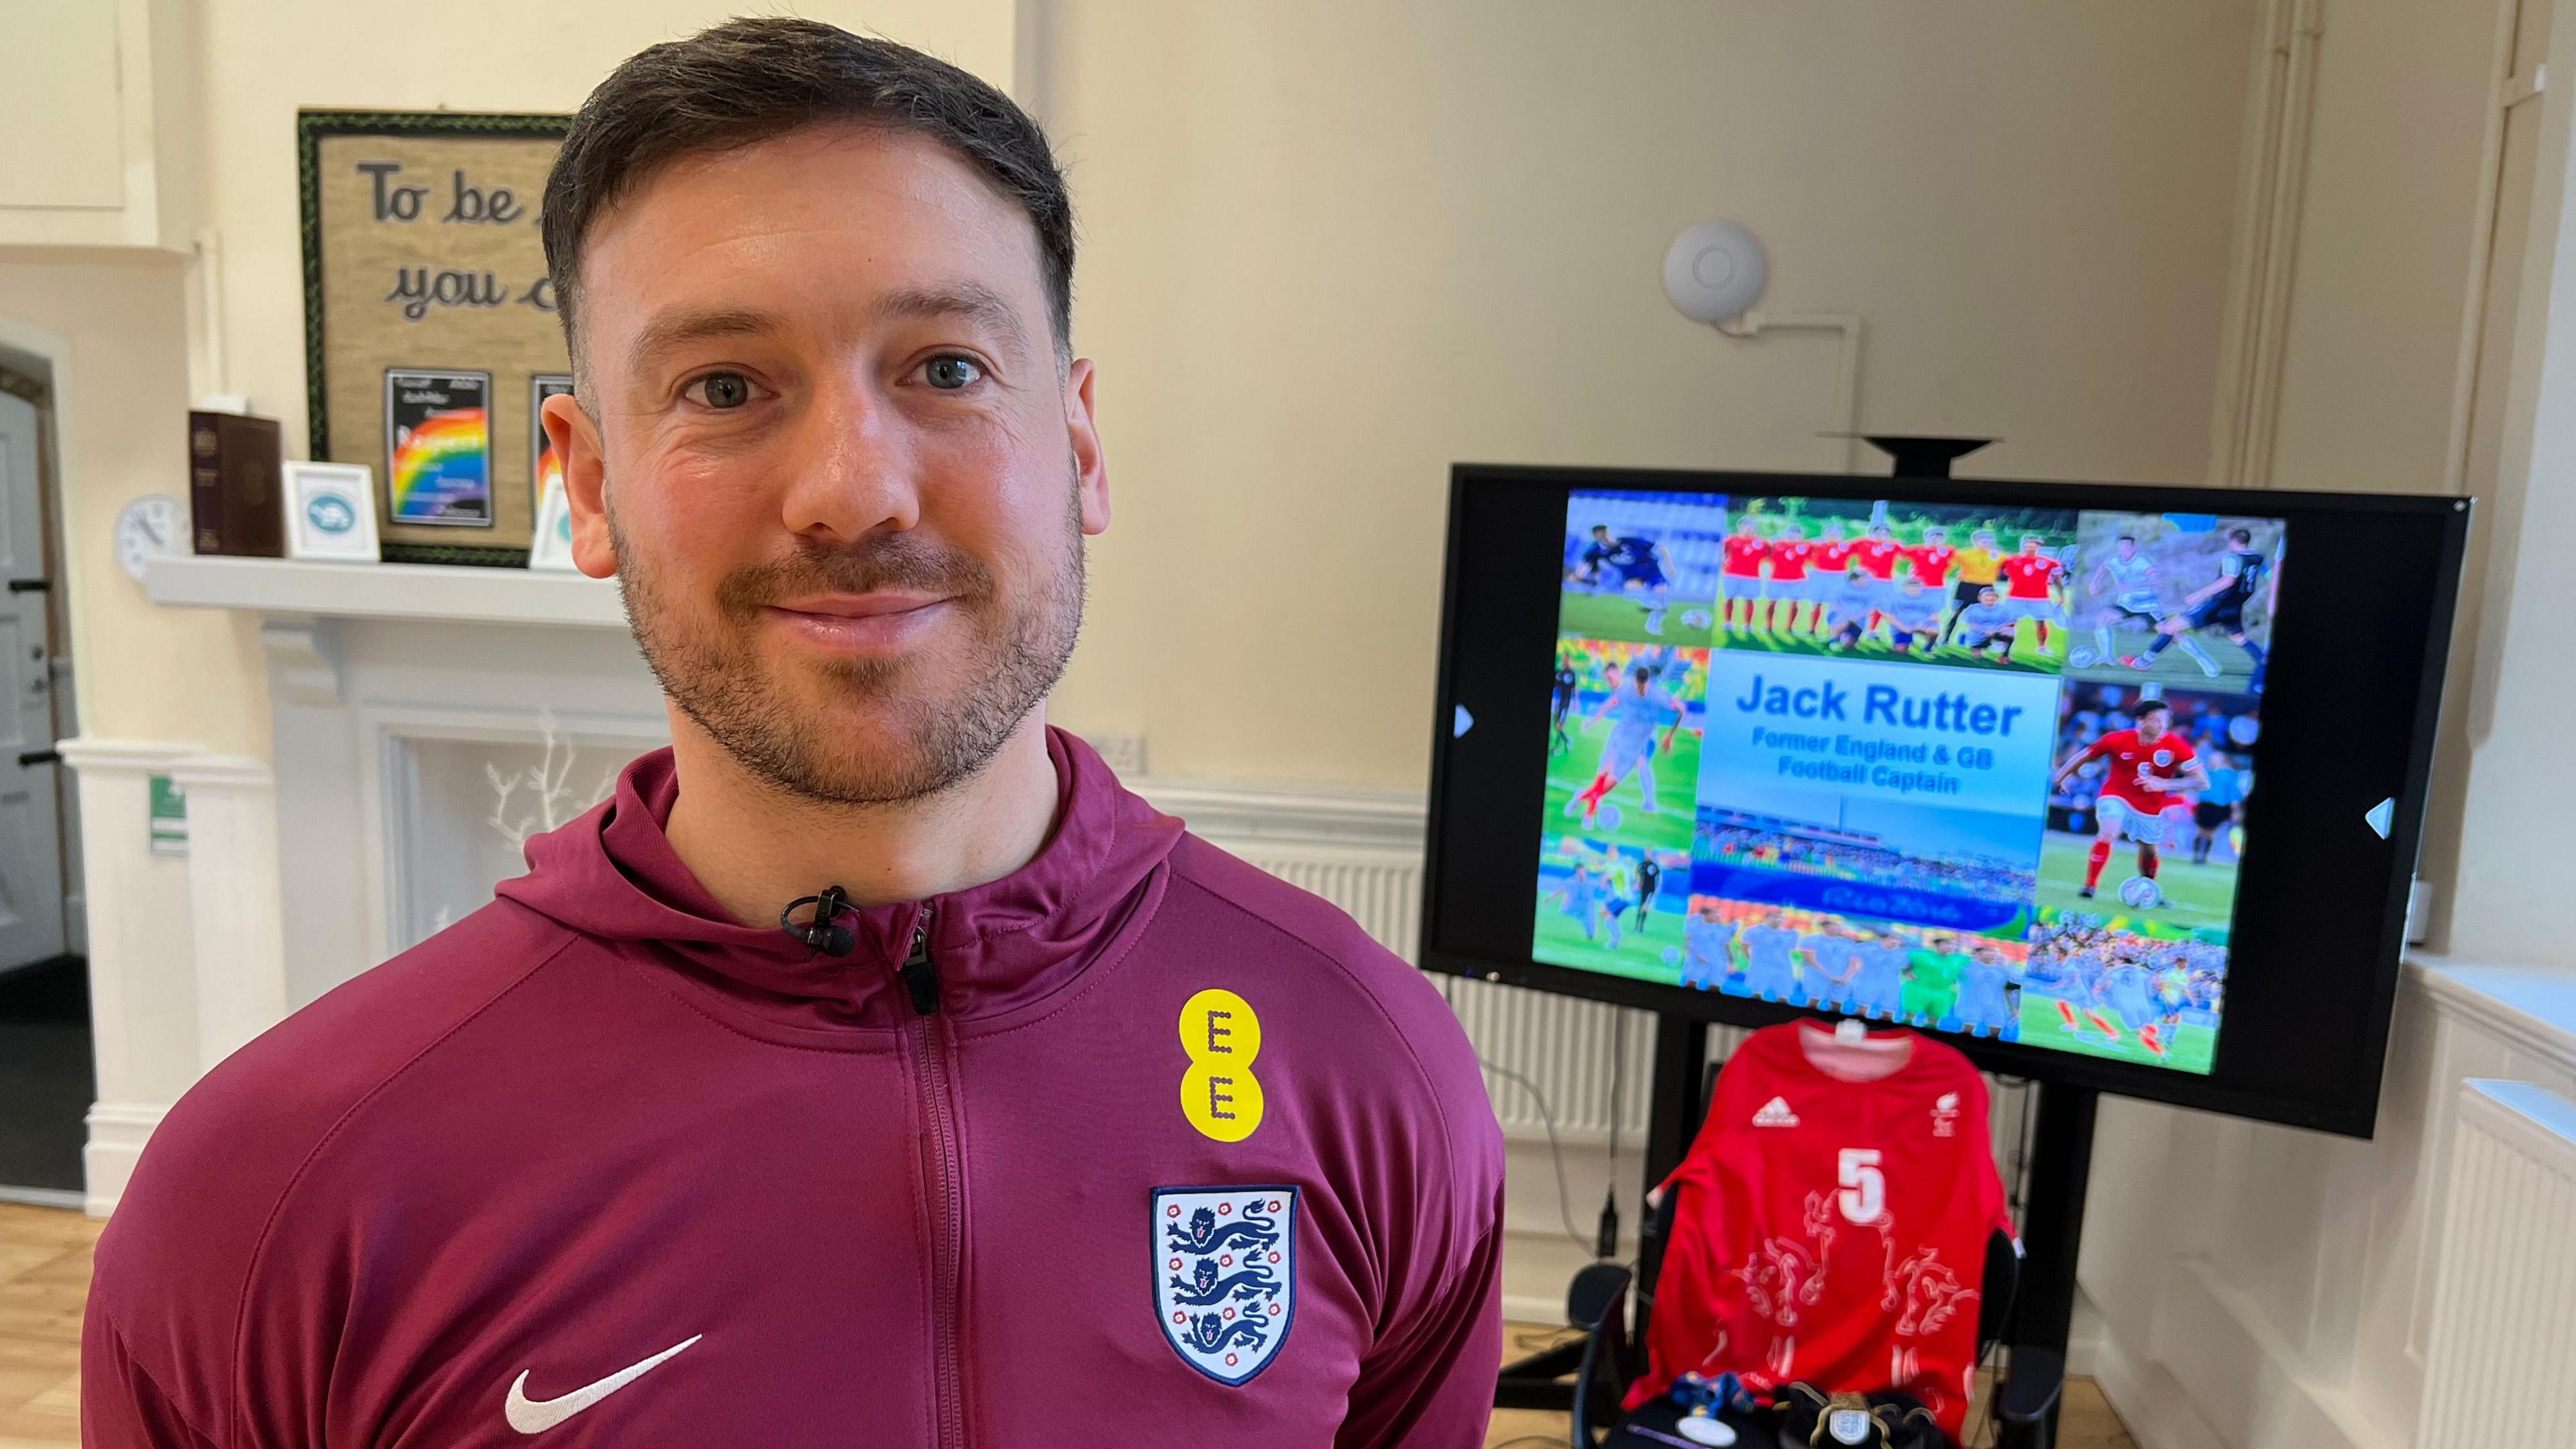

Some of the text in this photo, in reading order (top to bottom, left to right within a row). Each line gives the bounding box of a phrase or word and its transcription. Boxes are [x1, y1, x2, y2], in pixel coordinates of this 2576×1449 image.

[357, 162, 524, 225] To be
[384, 267, 508, 320] you
[1736, 674, 2023, 737] Jack Rutter
[1752, 726, 1994, 770] Former England & GB
[1778, 755, 1962, 795] Football Captain
[1838, 1148, 1886, 1226] 5
